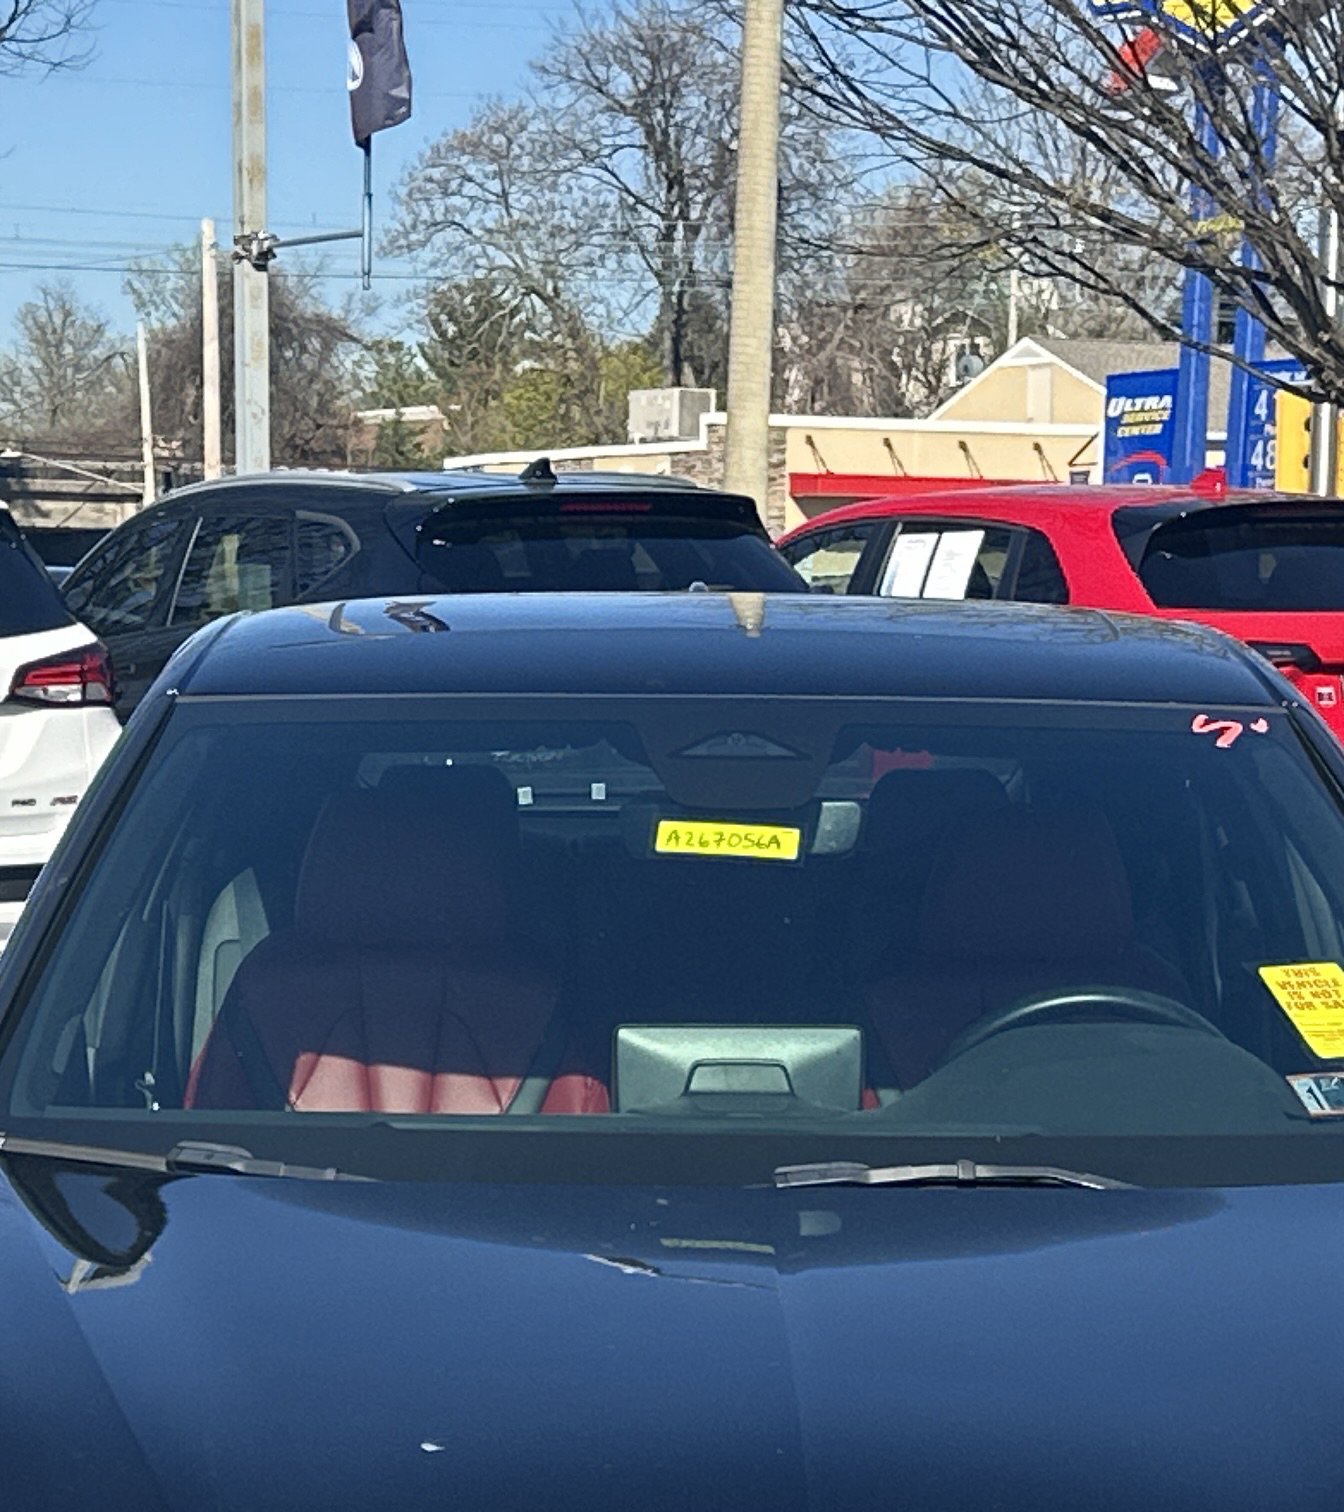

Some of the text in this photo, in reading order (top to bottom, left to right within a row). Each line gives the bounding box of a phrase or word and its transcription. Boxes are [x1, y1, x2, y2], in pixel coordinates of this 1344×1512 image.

[1107, 394, 1173, 418] ULTRA
[1120, 409, 1172, 424] SERVICE
[1116, 422, 1164, 438] CENTER
[664, 829, 781, 850] A267056A
[1280, 967, 1321, 979] THIS
[1276, 978, 1343, 990] VEHICLE
[1287, 989, 1343, 1002] IS NOT
[1286, 1000, 1317, 1012] FOR
